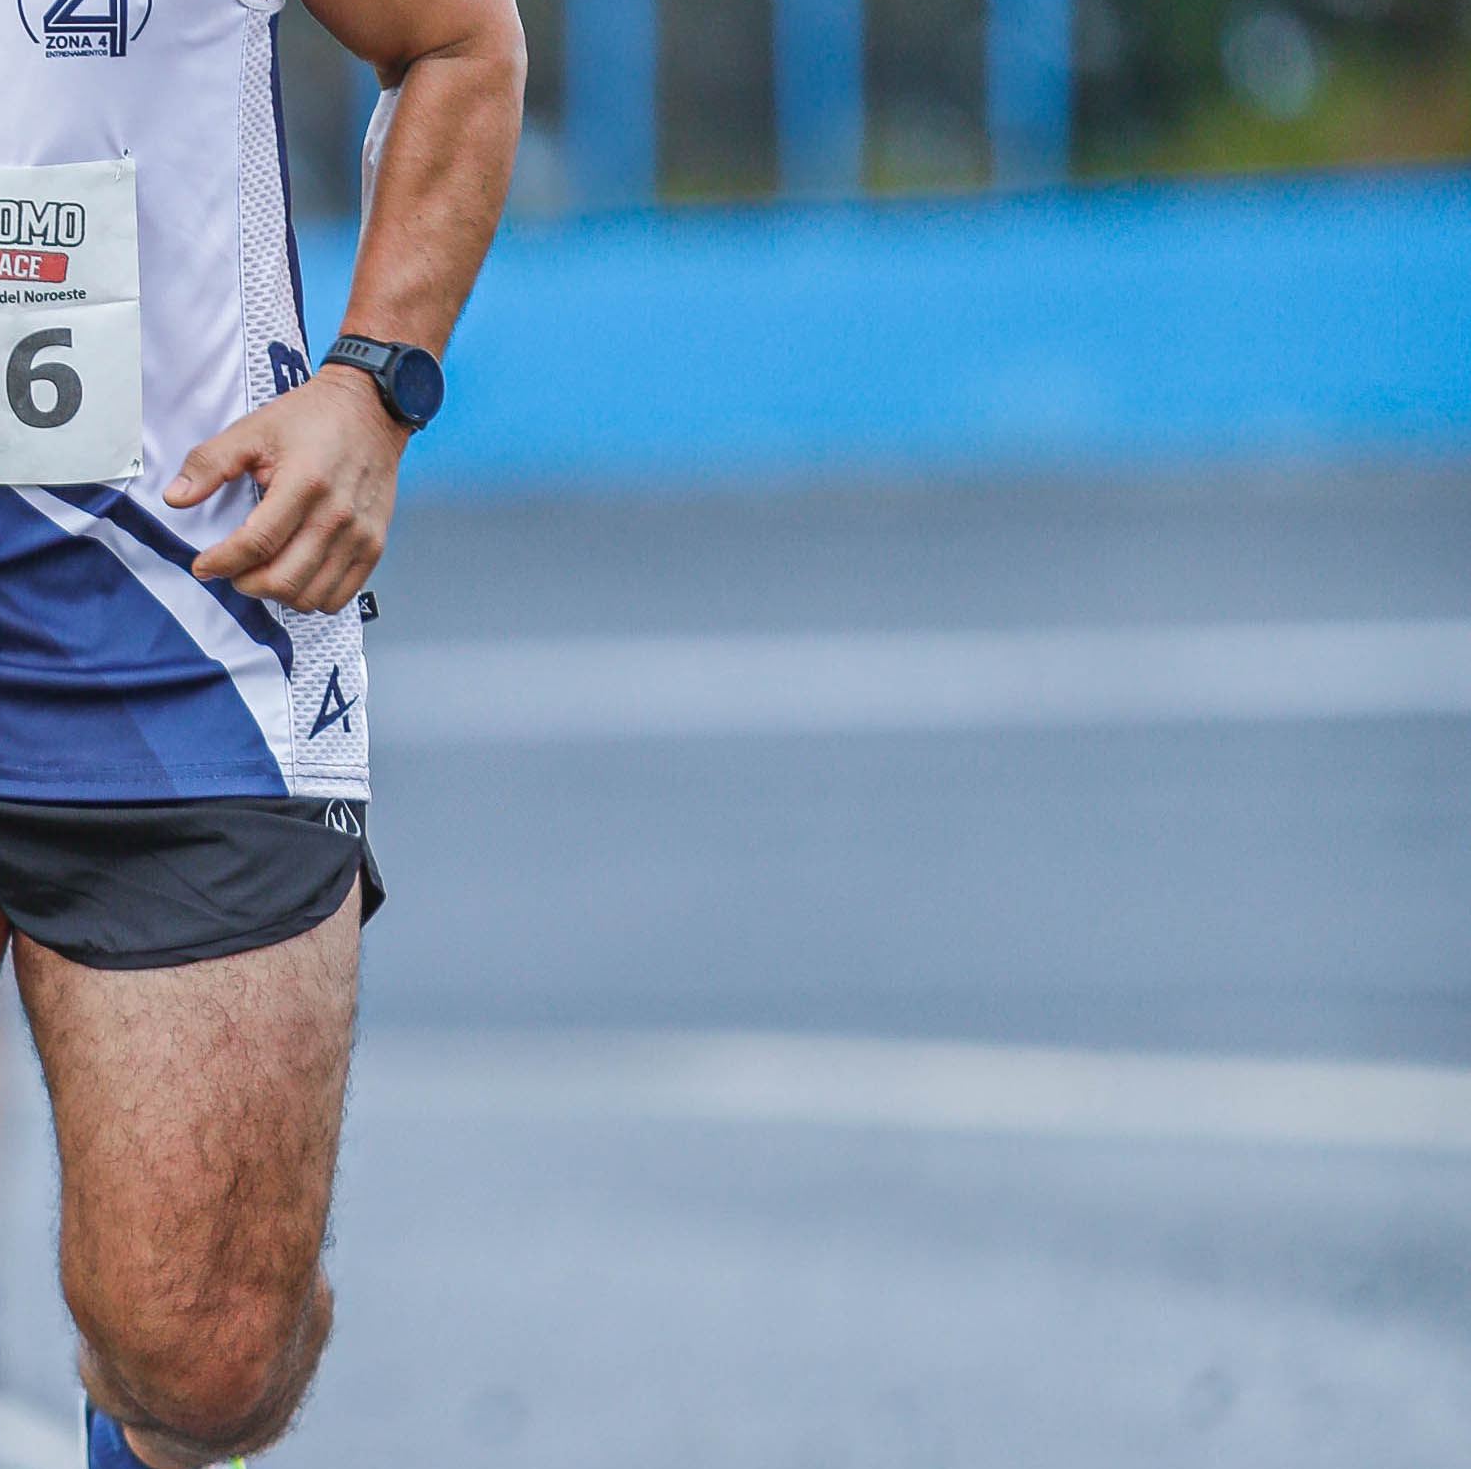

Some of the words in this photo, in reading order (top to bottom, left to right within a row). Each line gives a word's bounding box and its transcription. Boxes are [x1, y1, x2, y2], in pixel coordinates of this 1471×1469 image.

[45, 35, 92, 49] ZONA
[98, 35, 108, 48] 4
[23, 288, 88, 304] Noroeste
